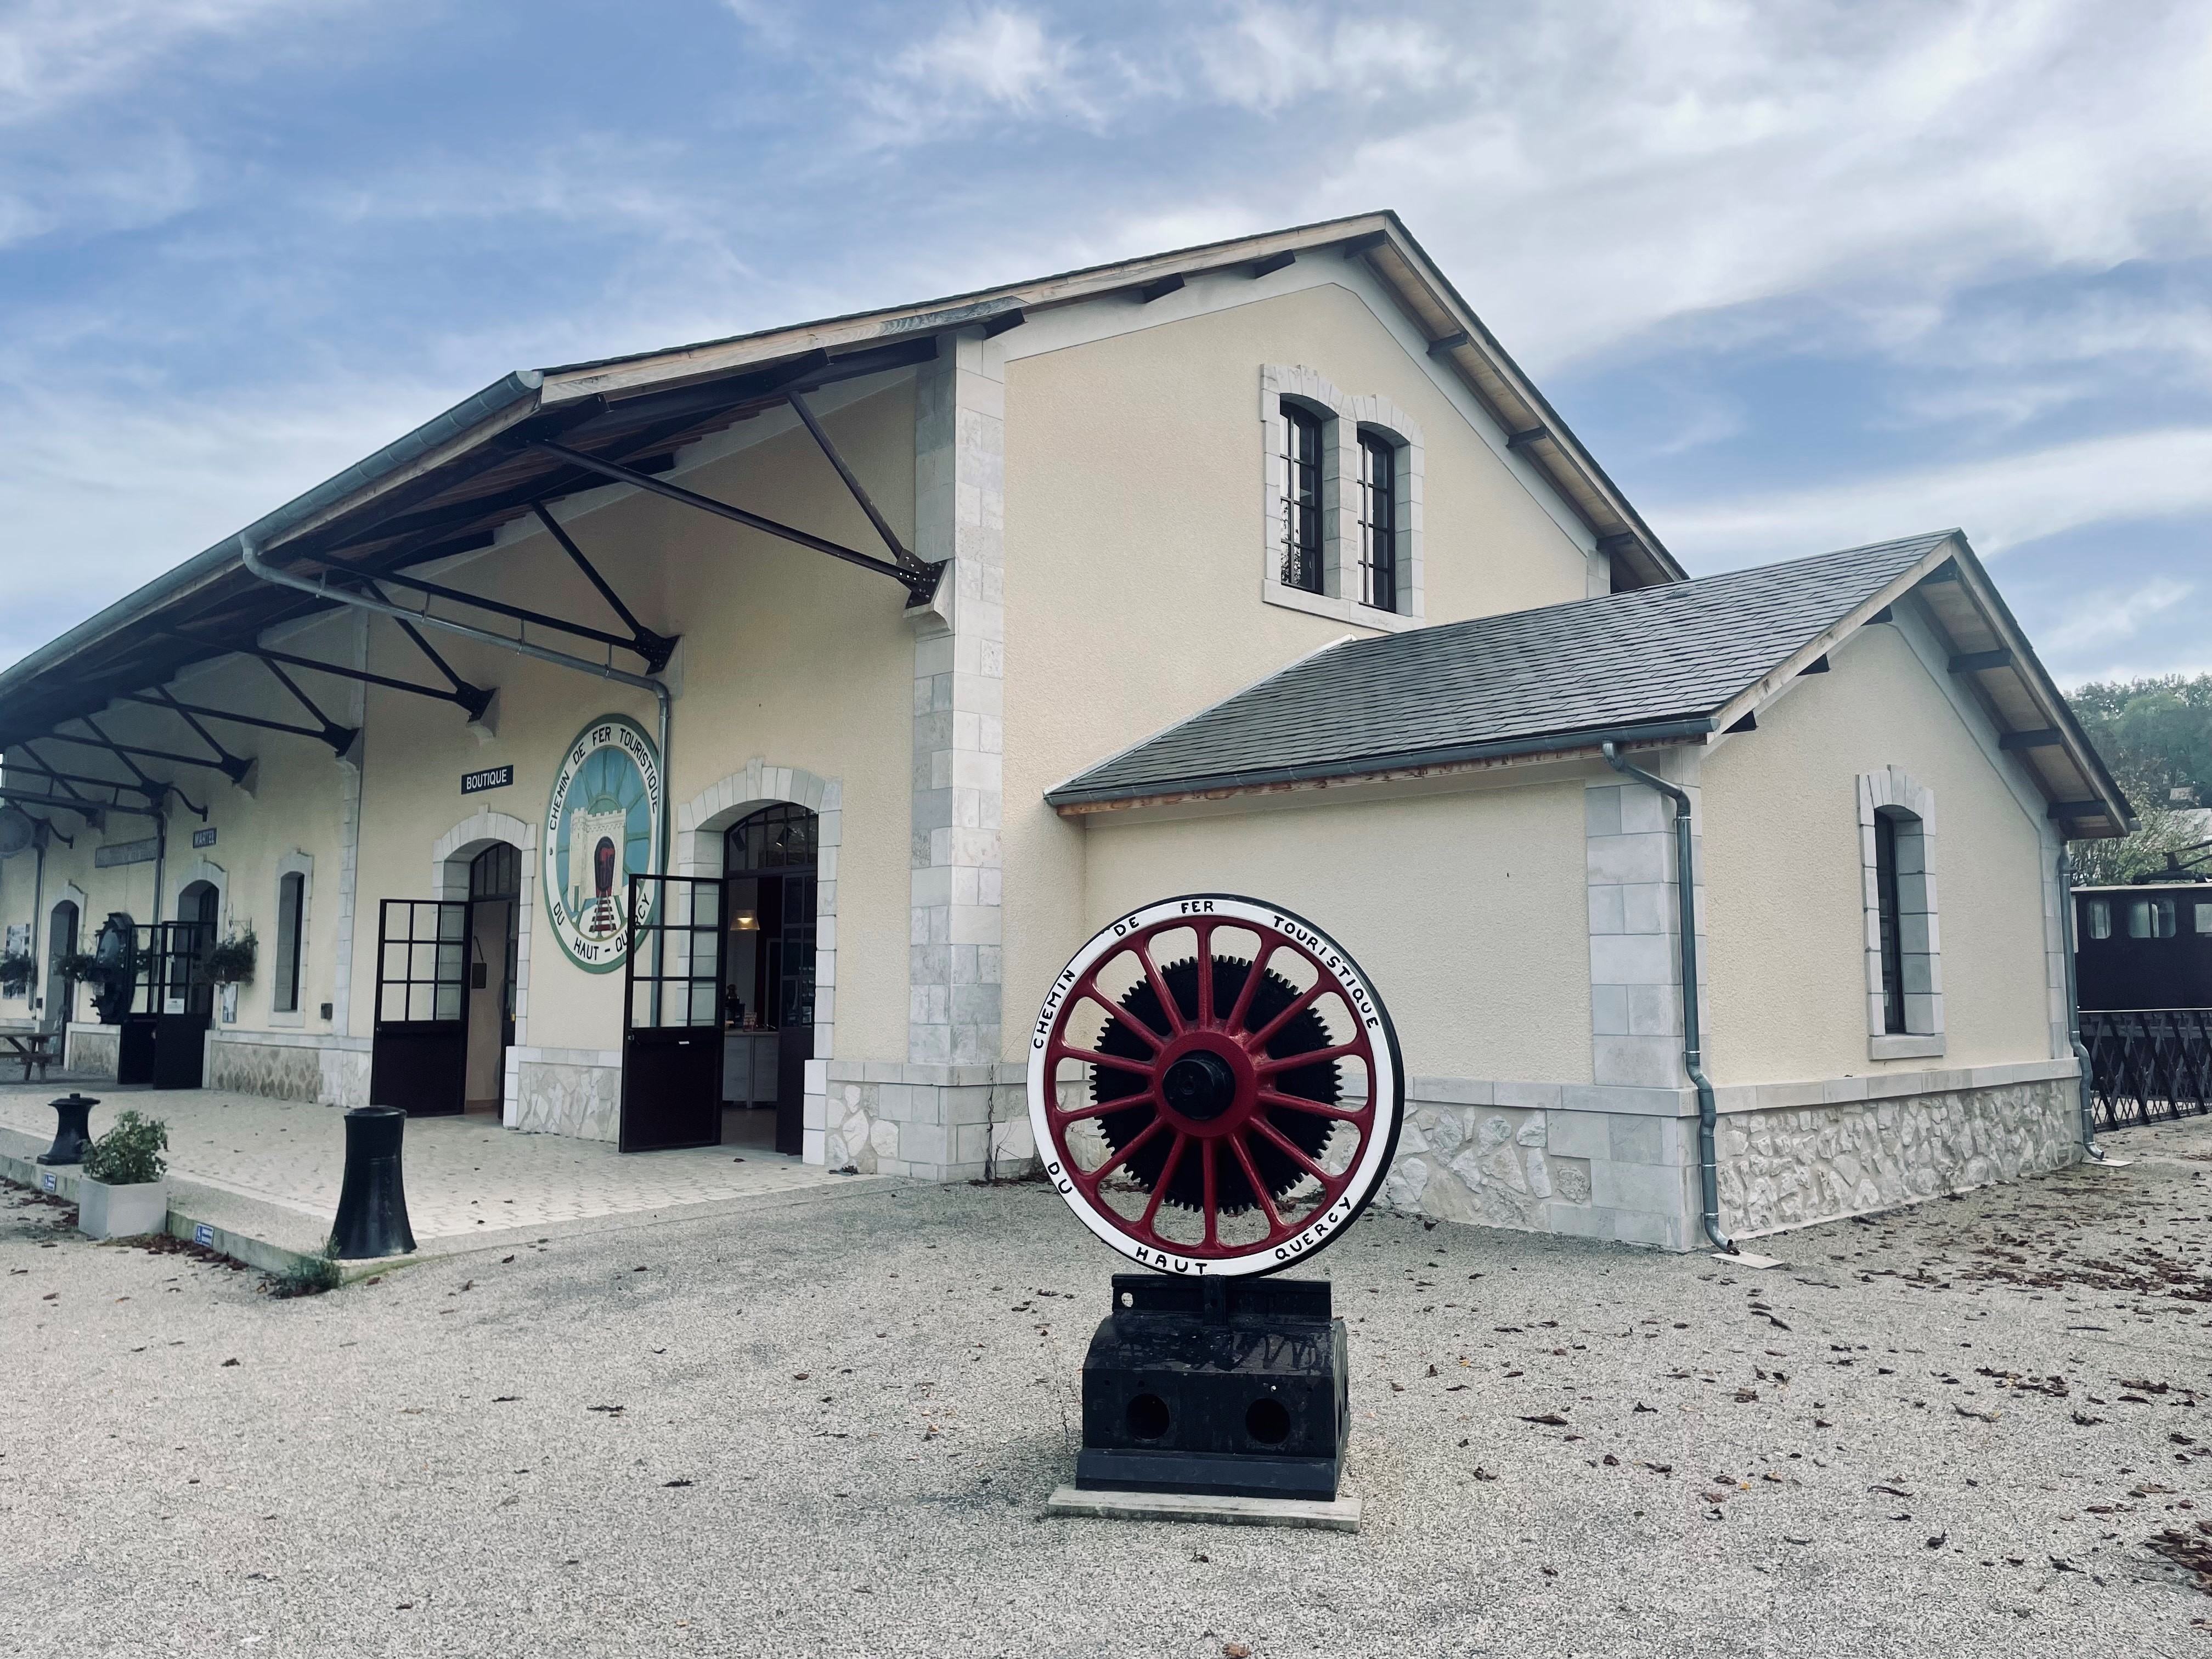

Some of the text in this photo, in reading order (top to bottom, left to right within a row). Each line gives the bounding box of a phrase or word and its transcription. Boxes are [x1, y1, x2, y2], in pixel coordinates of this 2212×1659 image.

[466, 769, 507, 790] BOUTIQUE
[550, 770, 570, 830] CHEMIN
[573, 742, 585, 765] DE
[592, 726, 611, 747] FER
[194, 830, 215, 846] MARTEL
[553, 901, 565, 926] DU
[574, 937, 599, 961] HAUT
[616, 893, 650, 952] QURCY
[1033, 900, 1379, 1049] CHEMIN DE FER TOURISTIQUE
[1047, 1161, 1351, 1275] DU HAUT QUERCY
